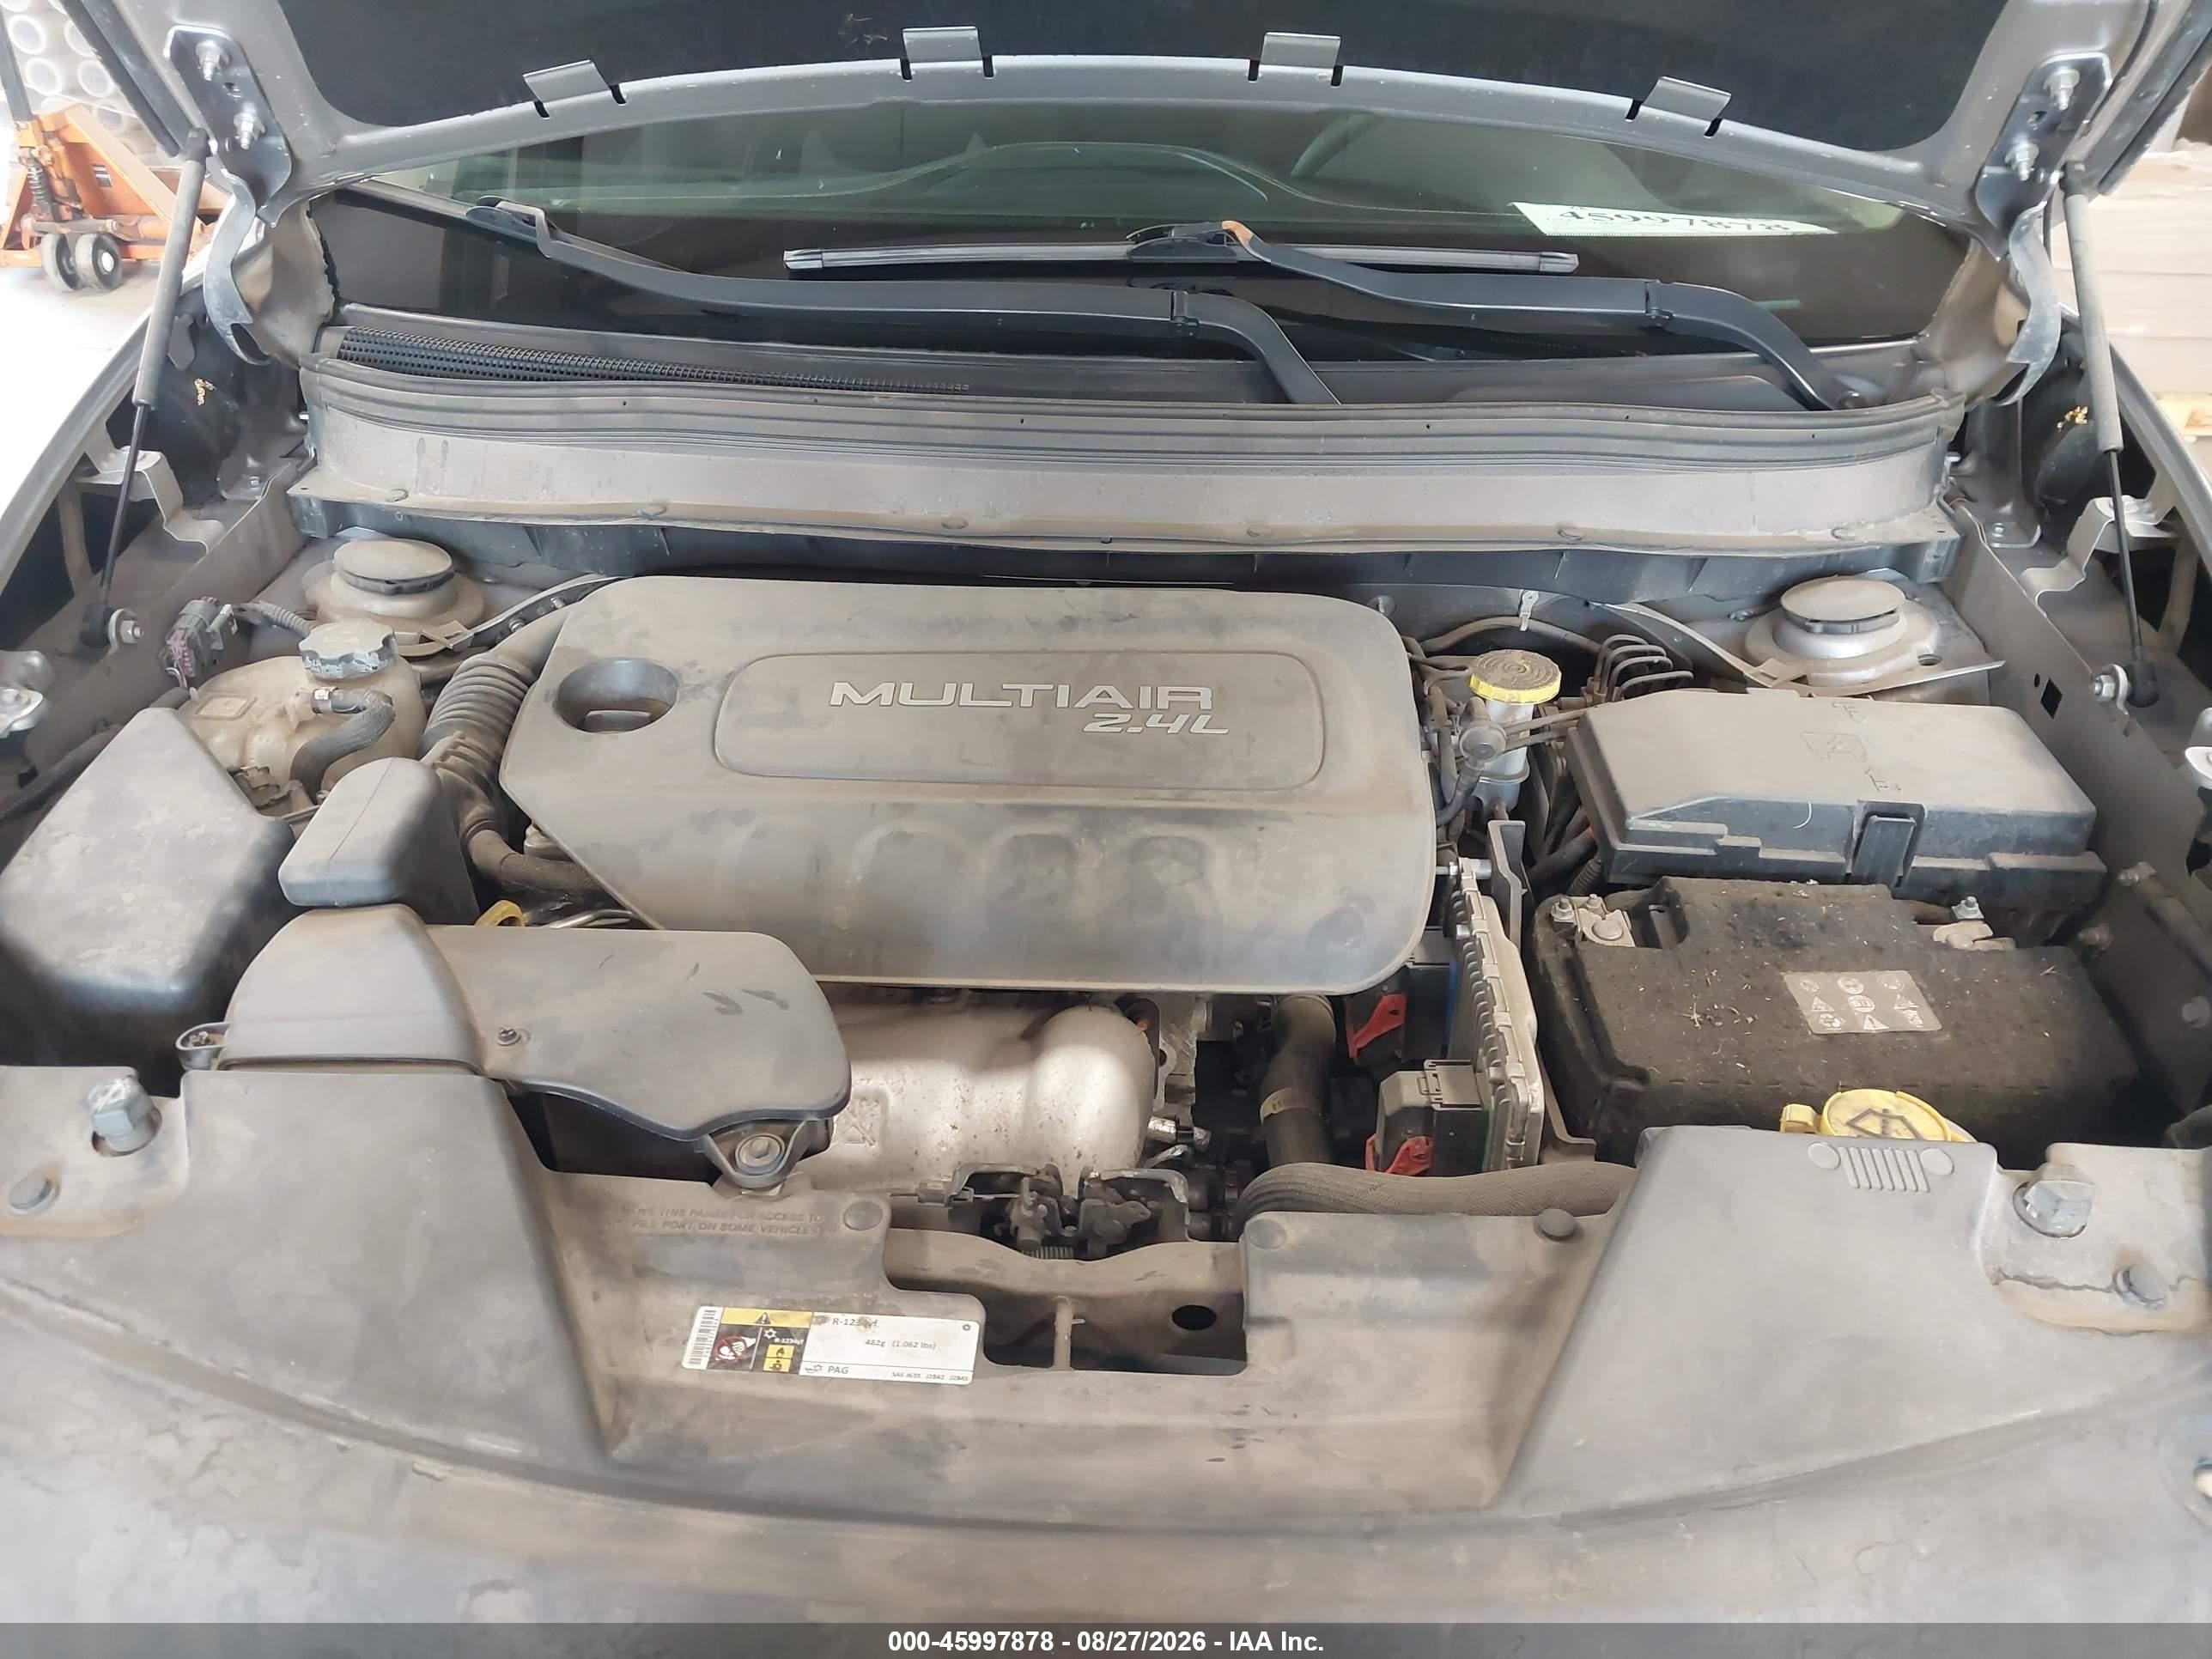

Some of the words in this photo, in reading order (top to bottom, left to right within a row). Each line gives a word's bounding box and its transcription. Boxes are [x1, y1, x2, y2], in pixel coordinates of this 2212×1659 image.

[1559, 211, 1790, 230] 45997878
[830, 682, 1212, 709] MULTIAIR
[1083, 713, 1230, 733] 2.4L
[808, 1213, 823, 1223] TO
[661, 1220, 693, 1231] PORT
[697, 1222, 717, 1231] ON
[720, 1223, 756, 1232] SOME
[760, 1224, 817, 1235] VEHICLES
[833, 1317, 878, 1329] R-123yf
[827, 1365, 849, 1375] PAG
